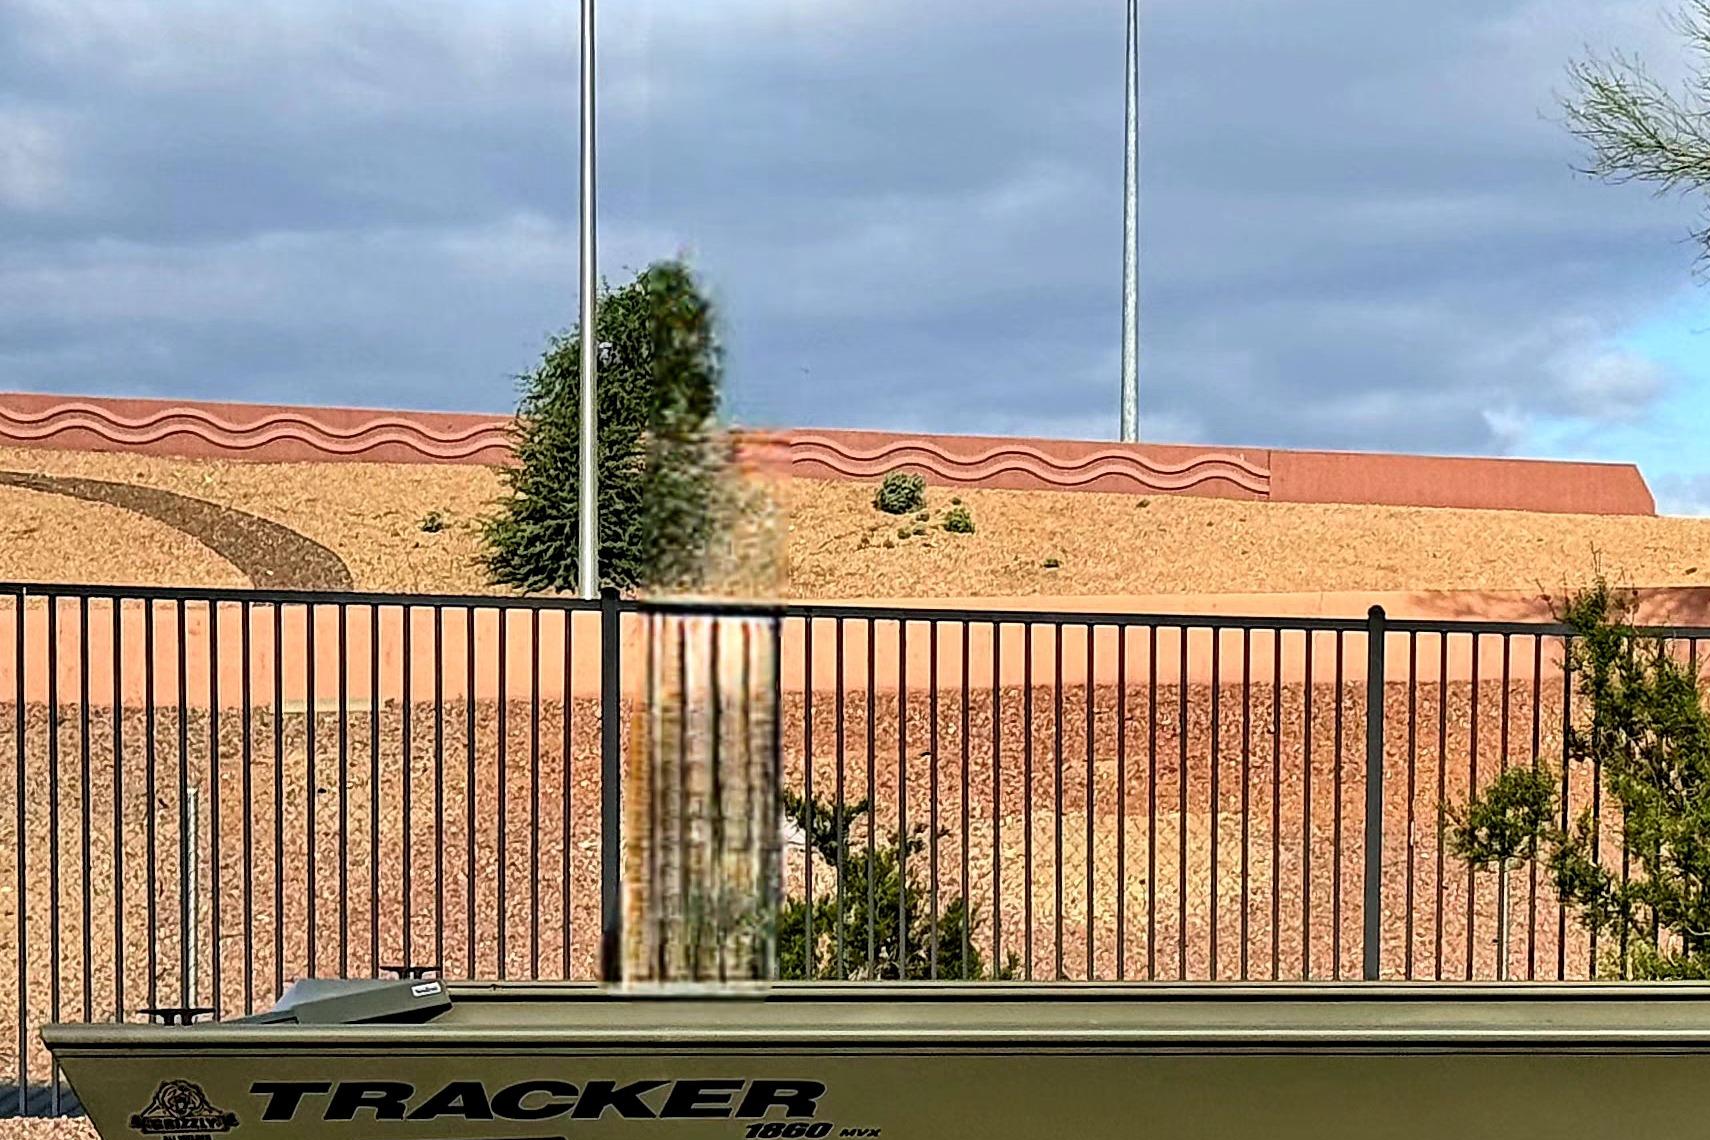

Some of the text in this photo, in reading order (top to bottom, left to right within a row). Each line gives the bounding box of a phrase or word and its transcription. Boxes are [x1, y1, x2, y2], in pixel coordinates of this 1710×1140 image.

[249, 1080, 826, 1121] TRACKER
[149, 1118, 217, 1130] GRIZZLY
[745, 1122, 882, 1139] 1860 MVX
